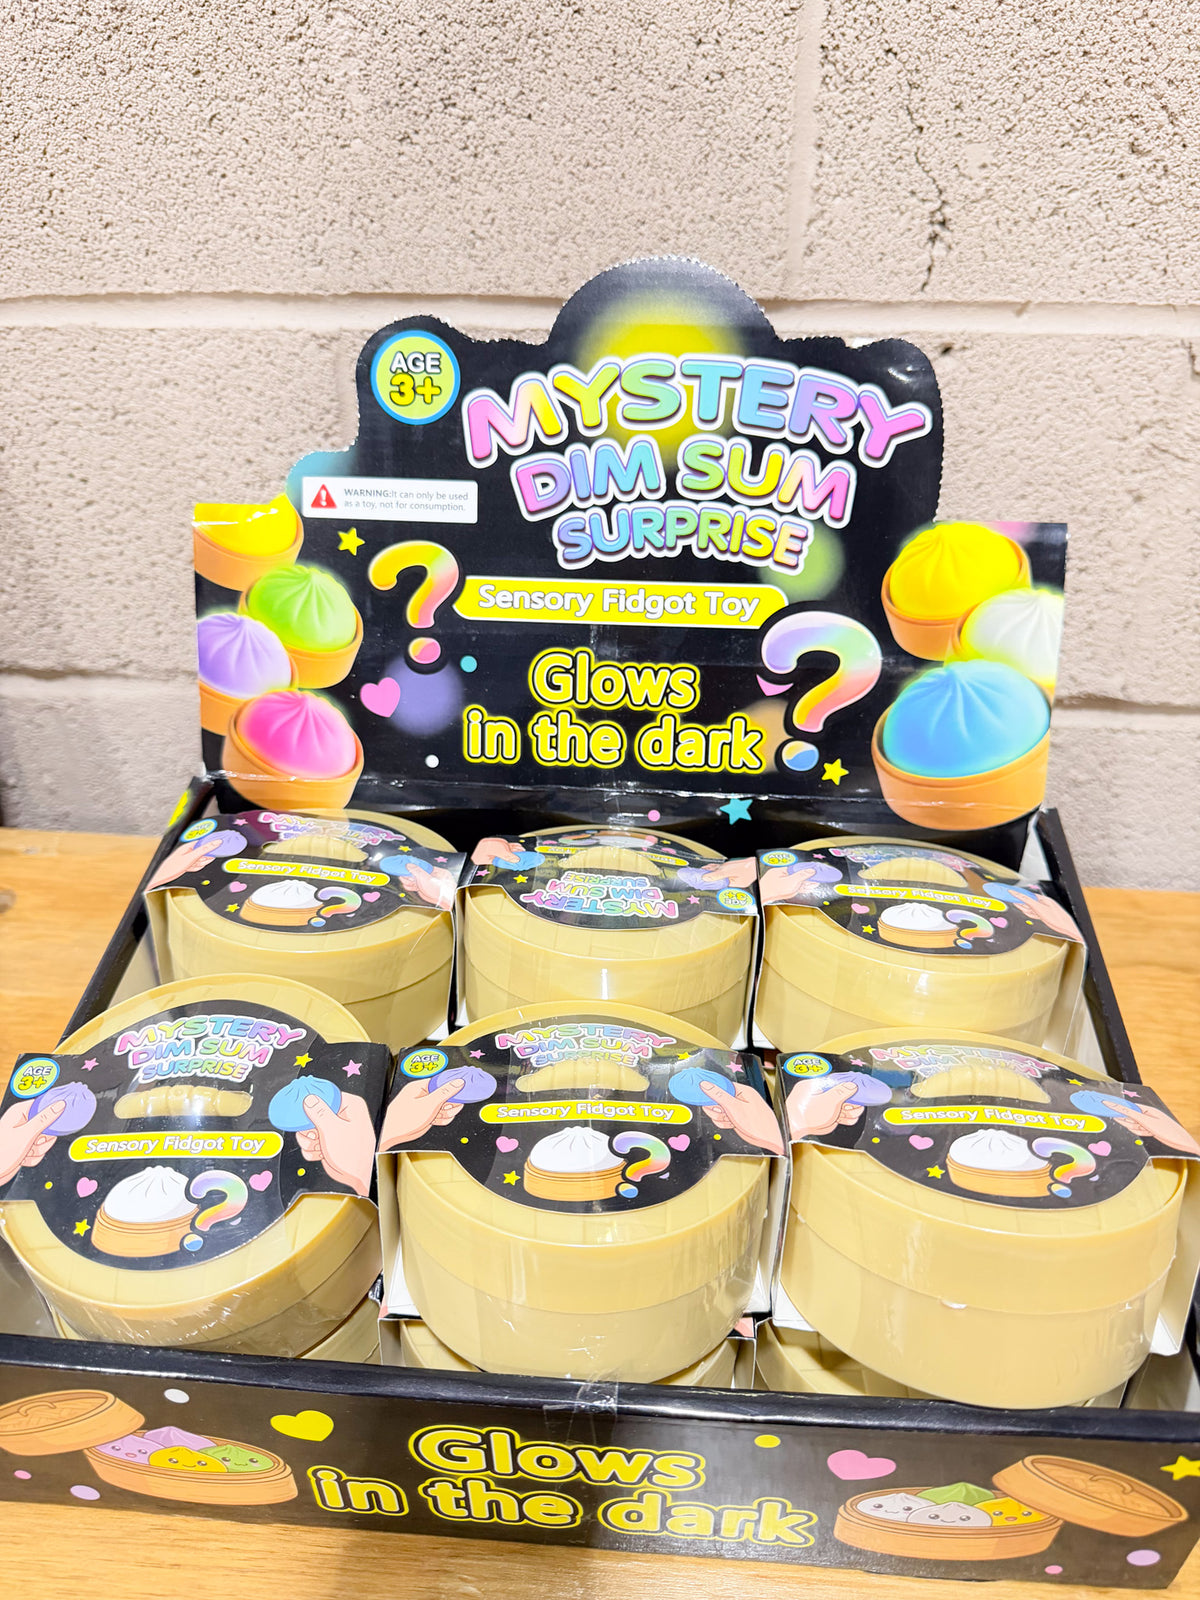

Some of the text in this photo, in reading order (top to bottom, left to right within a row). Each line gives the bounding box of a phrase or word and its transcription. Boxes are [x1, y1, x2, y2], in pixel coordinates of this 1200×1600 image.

[390, 352, 441, 375] AGE
[389, 373, 441, 406] 3+
[465, 356, 929, 464] MYSTERY
[514, 437, 854, 523] DIM SUM
[380, 501, 393, 509] not
[396, 501, 407, 510] for
[416, 491, 434, 502] only
[436, 491, 447, 500] be
[449, 492, 469, 501] used
[556, 503, 811, 571] SURPRISE
[478, 585, 760, 623] Sensory Fidgot Toy
[531, 650, 698, 708] Glows
[466, 709, 765, 770] in the dark
[237, 861, 376, 883] Sensory Fidgot Toy
[549, 881, 660, 900] DIM SUM
[911, 889, 961, 902] Fidgot
[964, 896, 992, 908] Toy
[522, 889, 677, 917] MYSTERY
[117, 1016, 304, 1053] MYSTERY
[497, 1024, 674, 1048] MYSTERY
[131, 1039, 271, 1067] DIM SUM
[516, 1037, 650, 1057] DIM SUM
[142, 1059, 250, 1082] SURPRISE
[411, 1054, 440, 1064] AGE
[23, 1065, 52, 1077] AGE
[18, 1075, 47, 1091] 3+
[497, 1103, 675, 1121] Sensory Fidgot Toy
[900, 1108, 1087, 1129] Sensory Fidgot Toy
[85, 1136, 266, 1154] Sensory Fidgot Toy
[412, 1428, 703, 1488] Glows
[310, 1468, 816, 1545] in the dark
